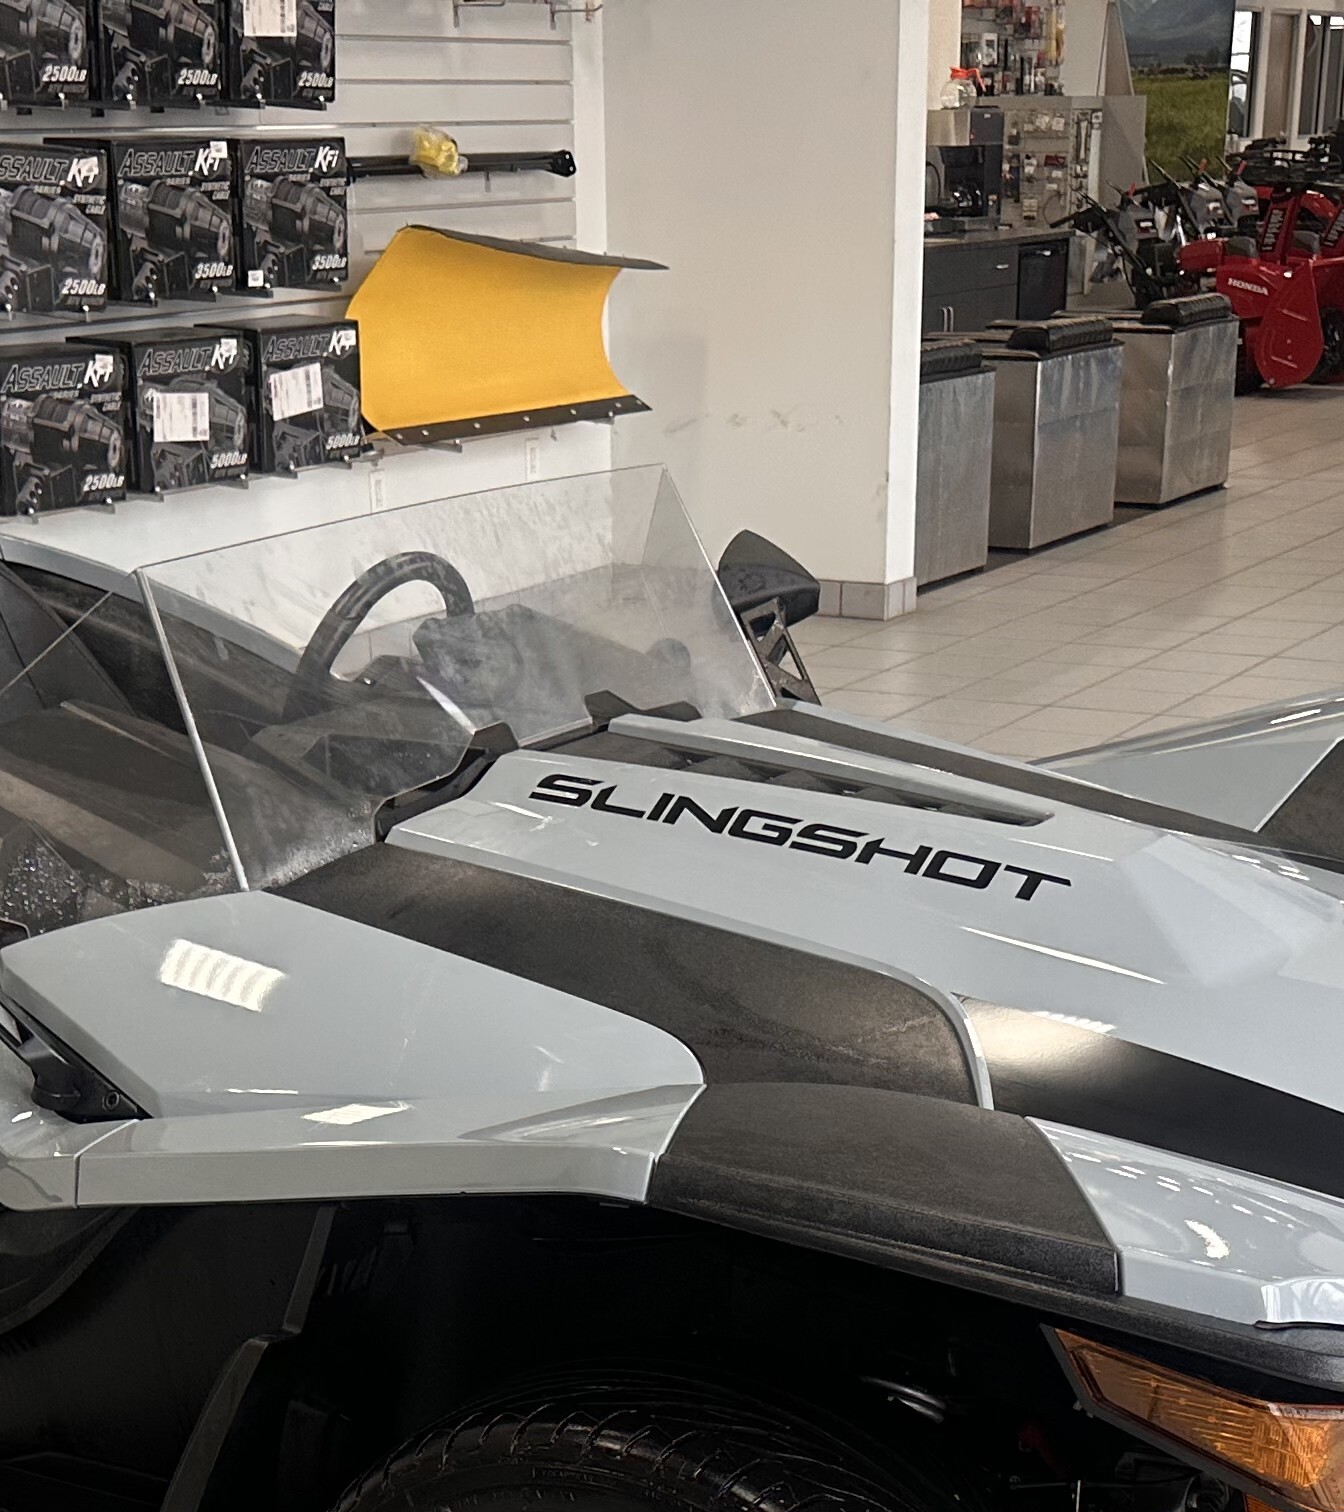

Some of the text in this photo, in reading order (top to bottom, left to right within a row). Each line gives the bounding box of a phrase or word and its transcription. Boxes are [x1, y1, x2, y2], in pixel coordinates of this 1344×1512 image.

[118, 149, 193, 177] ASSAULT
[244, 146, 316, 173] ASSAULT
[1227, 278, 1269, 297] HONDA
[263, 334, 330, 362] ASSAULT
[138, 349, 212, 376] ASSAULT
[0, 363, 85, 393] ASSAULT
[528, 773, 1072, 901] SLINGSHOT
